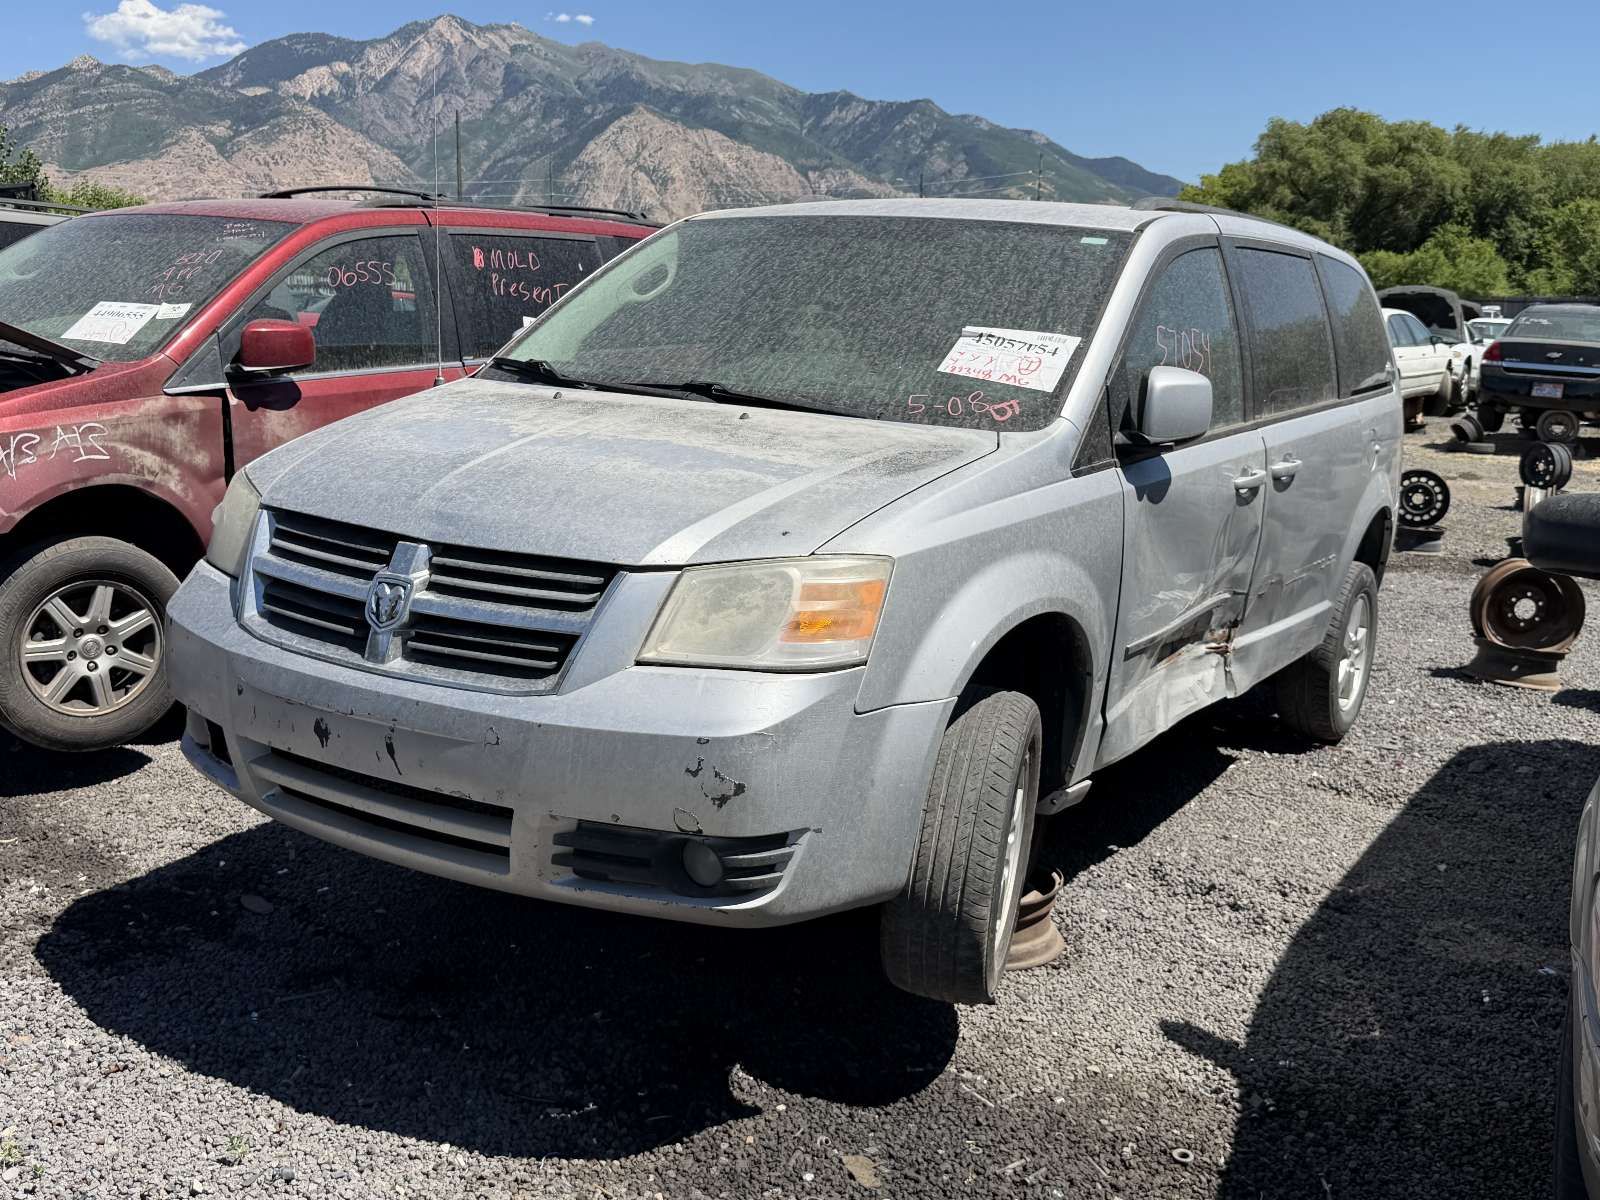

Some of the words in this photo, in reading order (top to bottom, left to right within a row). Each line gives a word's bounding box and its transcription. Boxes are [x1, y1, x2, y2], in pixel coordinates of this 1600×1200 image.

[490, 248, 541, 271] MOLD
[327, 261, 396, 288] 06555
[1156, 325, 1212, 374] 57054
